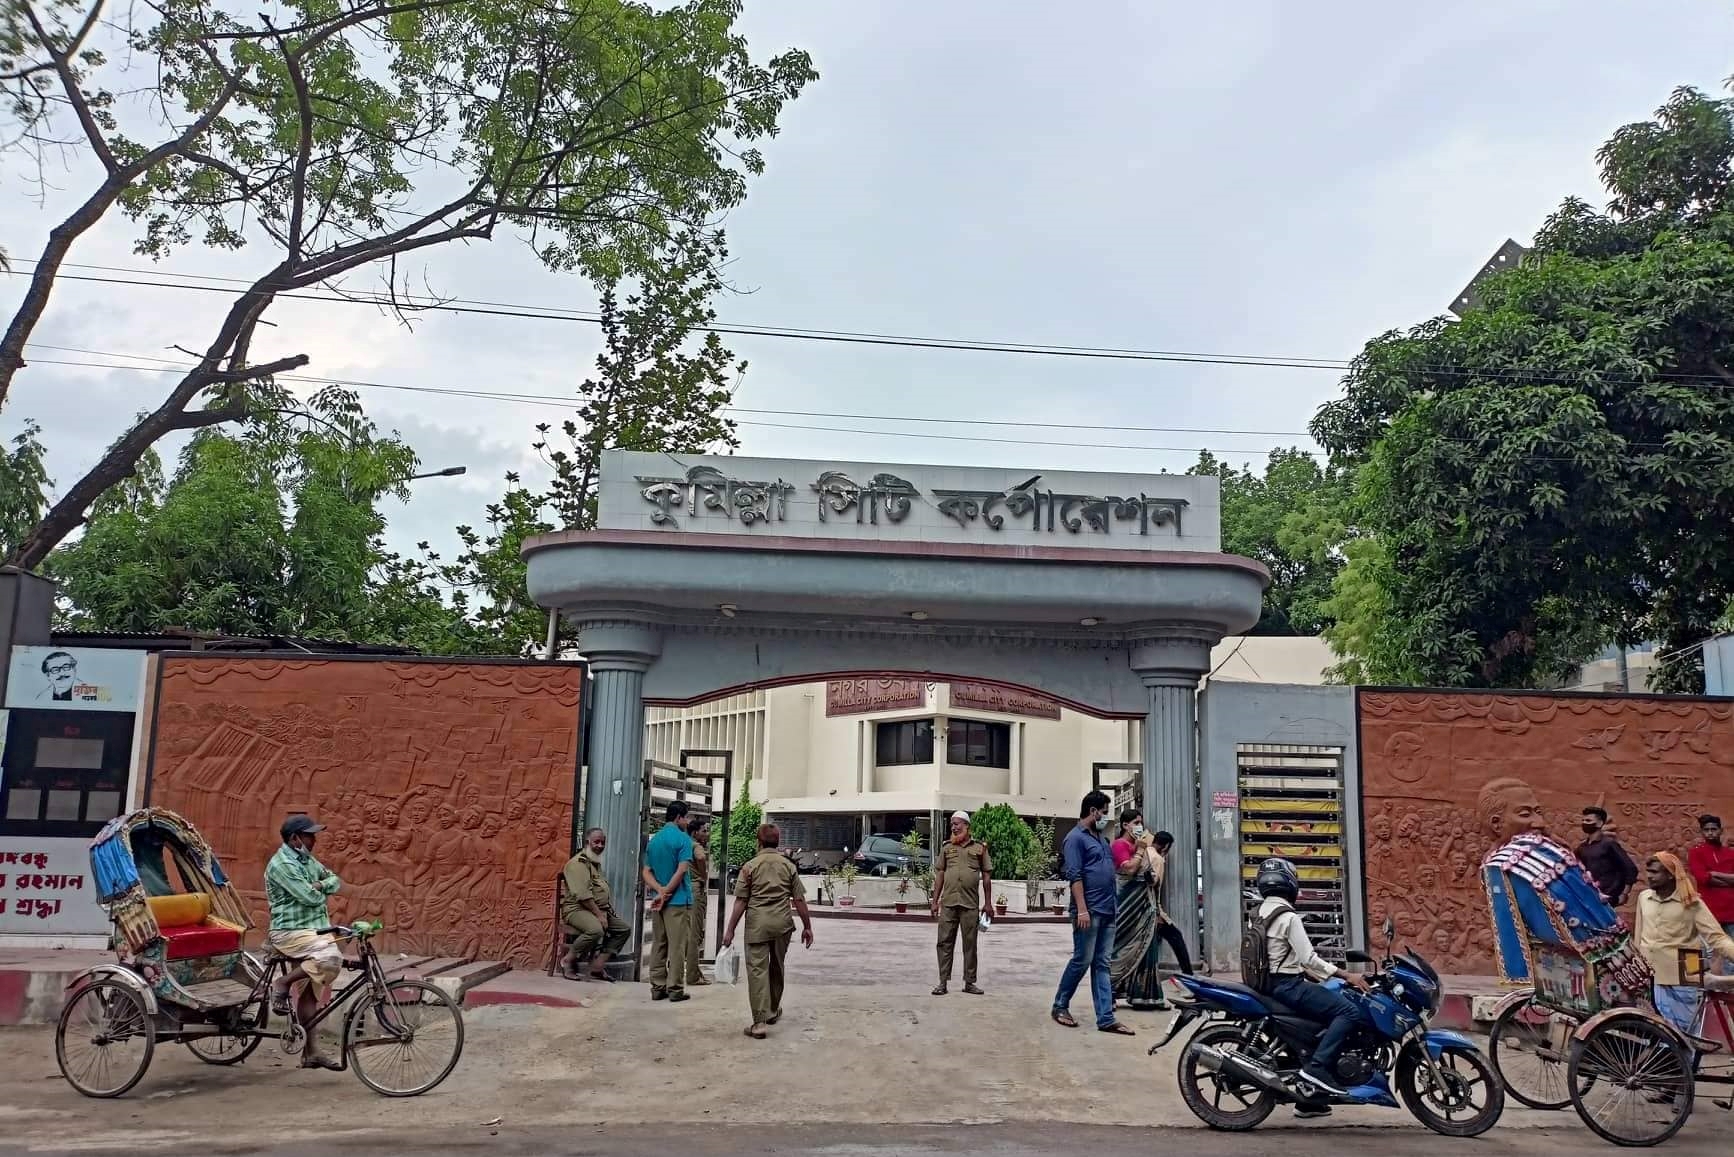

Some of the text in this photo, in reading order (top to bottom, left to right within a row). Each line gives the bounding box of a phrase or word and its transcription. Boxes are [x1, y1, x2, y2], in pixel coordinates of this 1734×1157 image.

[632, 465, 1191, 537] কুমিল্লা সিটি কর্পোরেশন
[16, 874, 84, 890] রহমান
[16, 899, 62, 919] শ্রদ্ধা
